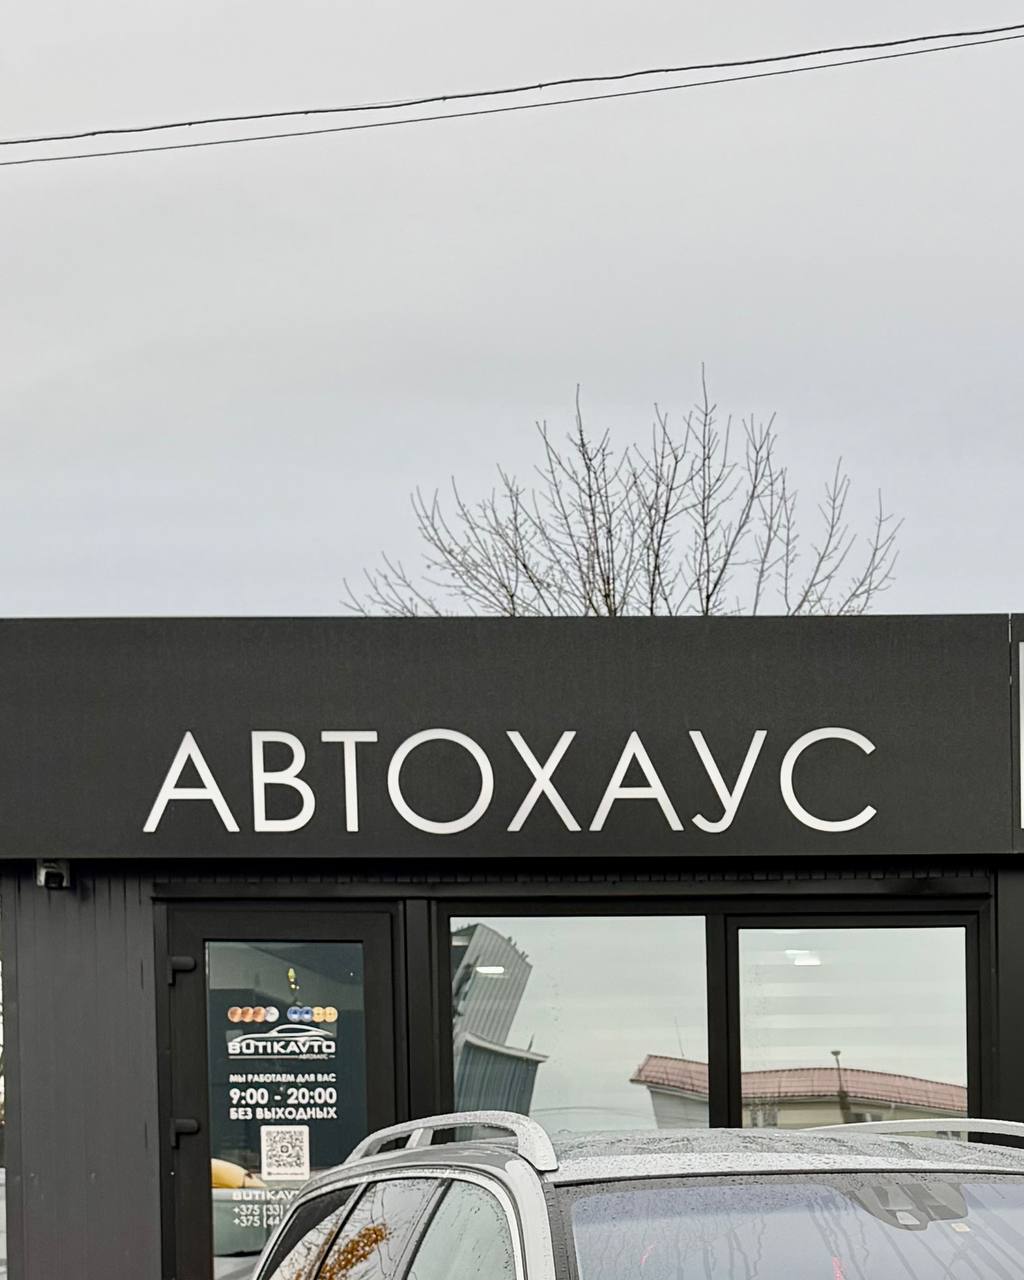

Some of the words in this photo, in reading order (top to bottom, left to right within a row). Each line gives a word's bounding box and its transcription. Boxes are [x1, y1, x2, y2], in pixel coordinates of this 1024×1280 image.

[143, 726, 878, 835] АВТОХАУС
[228, 1041, 336, 1054] BUTIKAVTO
[229, 1073, 246, 1083] МЫ
[247, 1073, 295, 1083] РАБОТАЕМ
[296, 1073, 315, 1083] ДЛЯ
[317, 1073, 336, 1082] ВАС
[229, 1088, 269, 1104] 9:00
[287, 1087, 337, 1104] 20:00
[229, 1107, 252, 1119] БЕЗ
[255, 1107, 337, 1120] ВЫХОДНЫХ
[233, 1204, 260, 1215] +375
[233, 1216, 260, 1227] +375
[263, 1215, 281, 1228] (44
